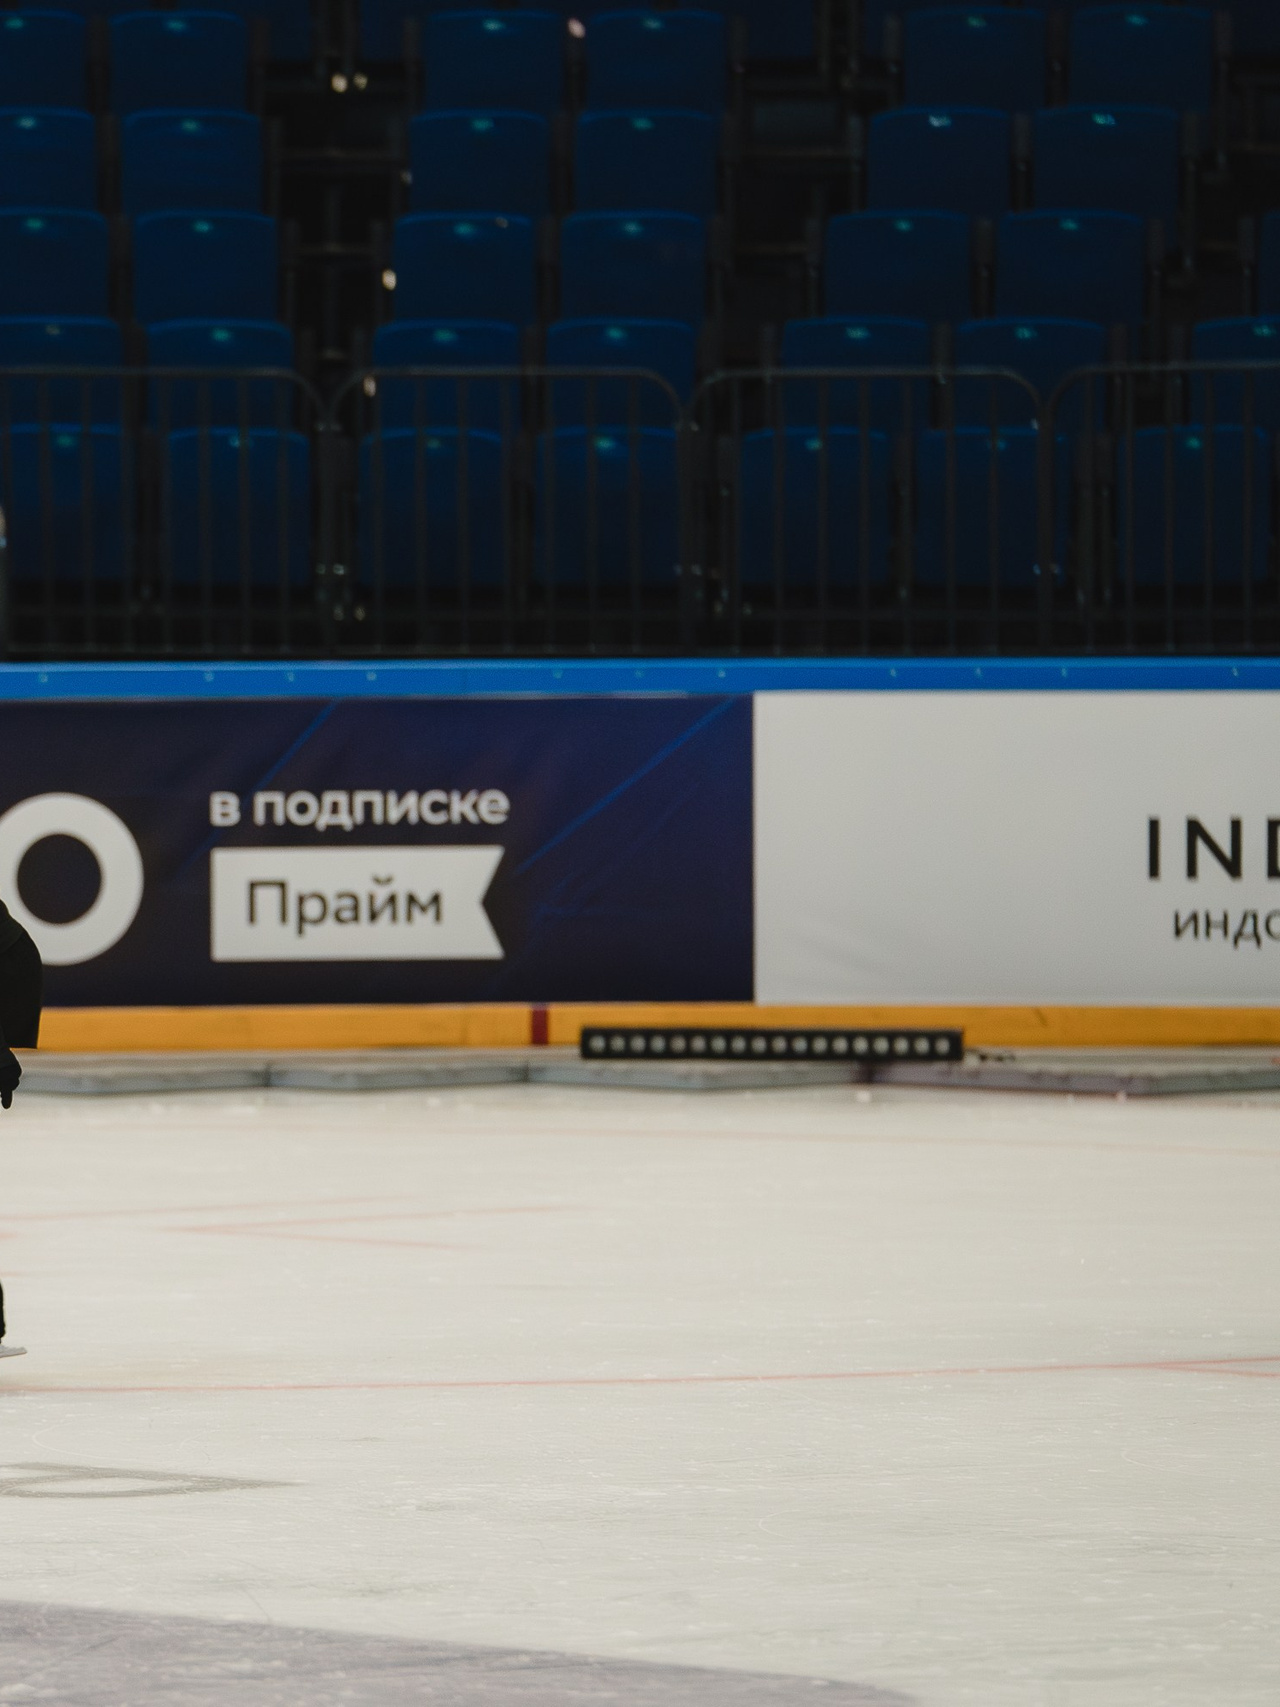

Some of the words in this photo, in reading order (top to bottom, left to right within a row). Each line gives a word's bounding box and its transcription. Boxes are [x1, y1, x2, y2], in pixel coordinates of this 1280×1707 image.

[210, 791, 241, 827] в
[253, 788, 510, 832] подписке
[247, 874, 443, 938] Прайм
